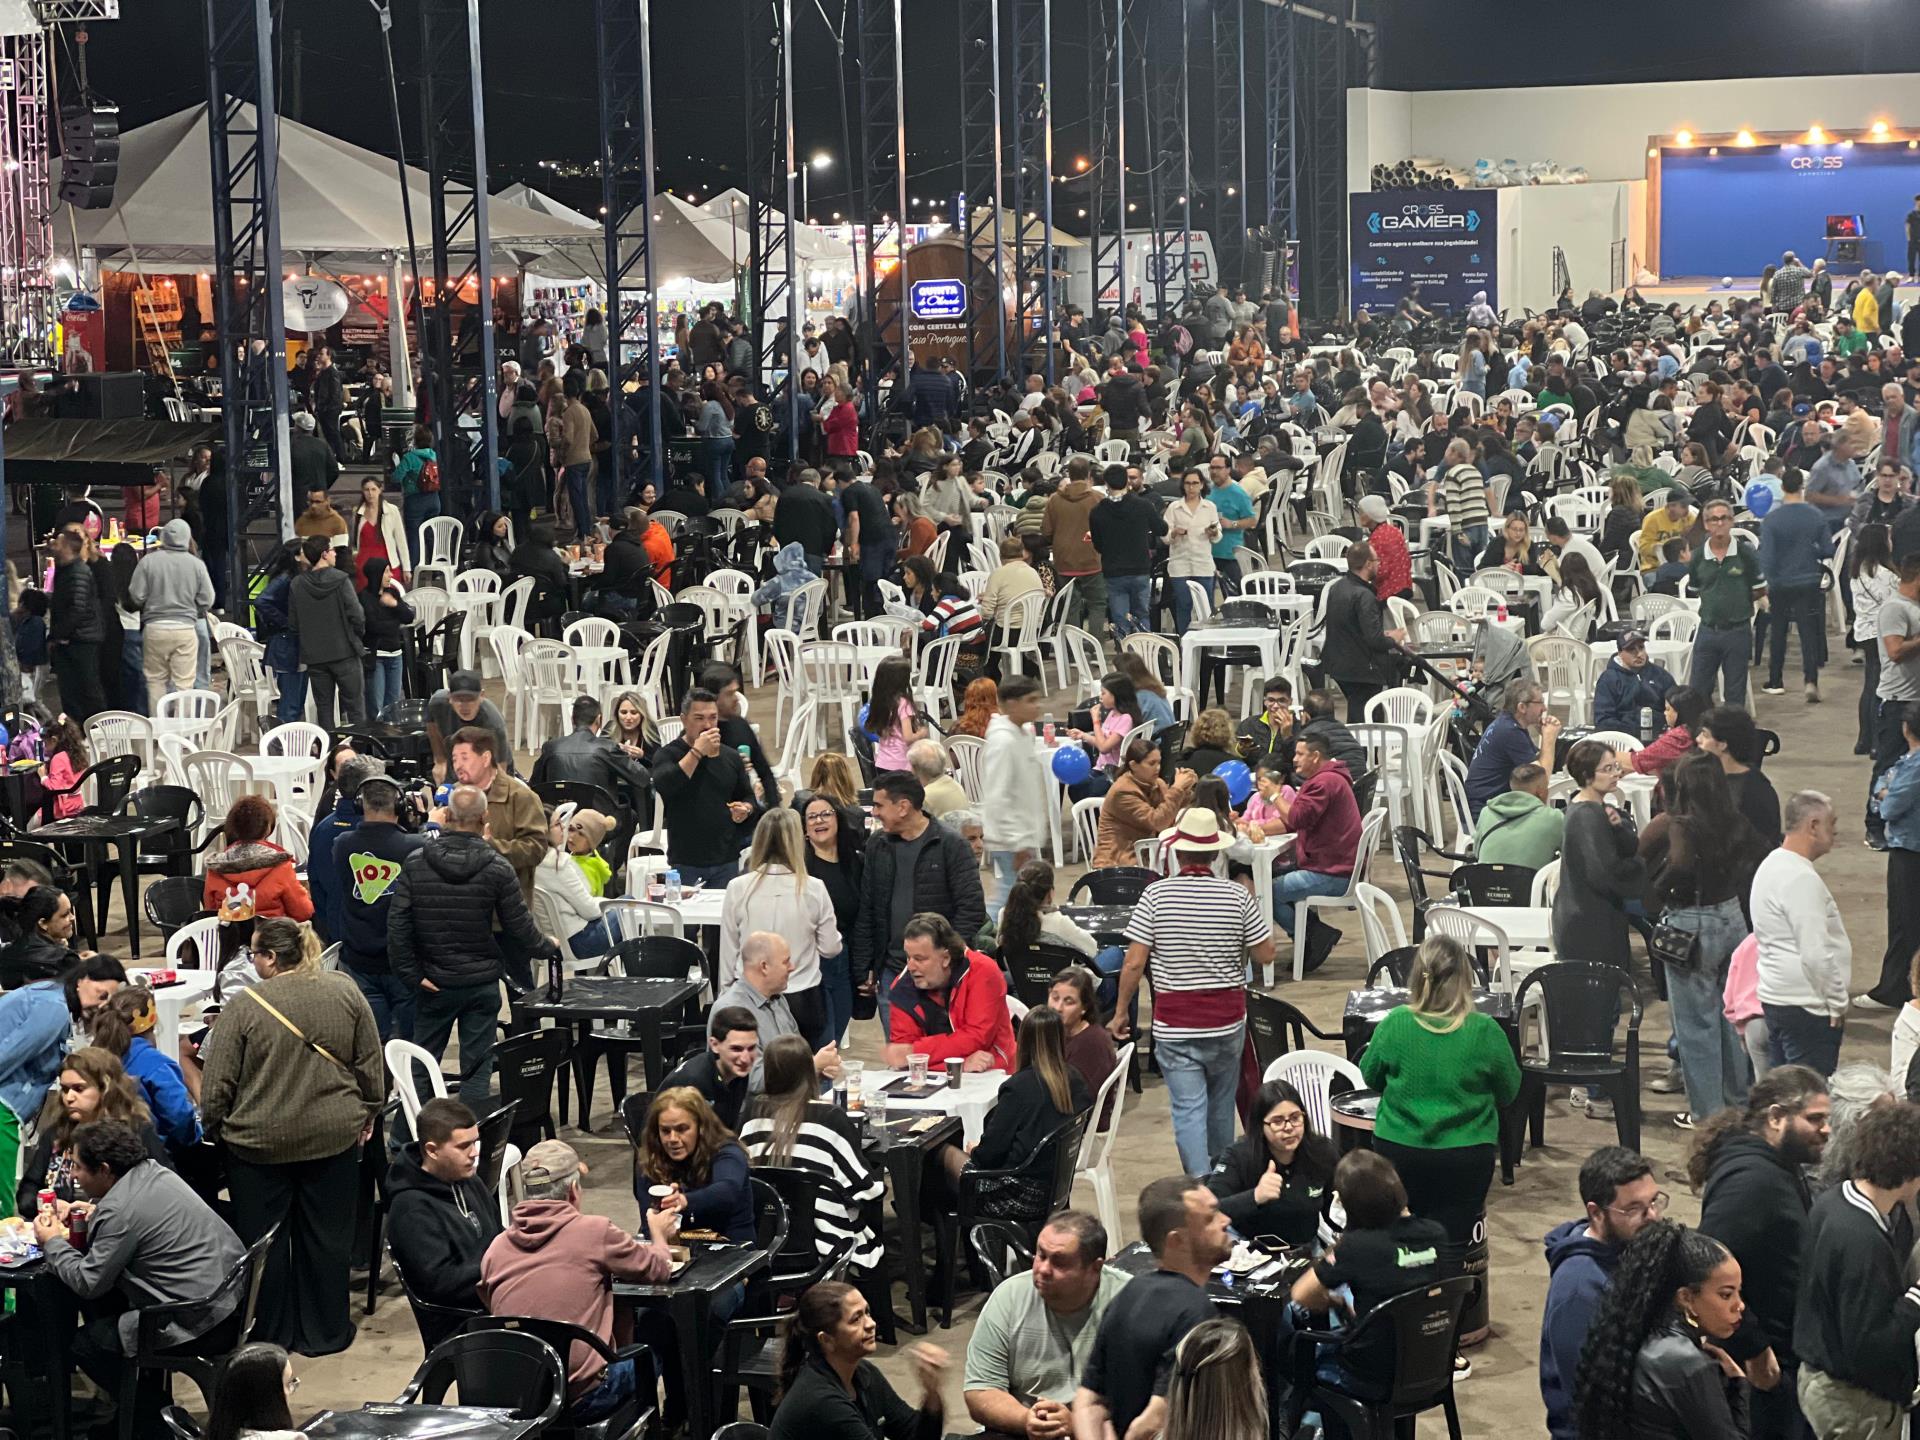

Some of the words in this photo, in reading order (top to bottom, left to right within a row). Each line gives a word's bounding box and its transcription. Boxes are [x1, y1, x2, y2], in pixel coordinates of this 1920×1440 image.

[1791, 156, 1843, 169] CROSS
[1402, 204, 1444, 215] CROSS
[1382, 214, 1465, 229] GAMER
